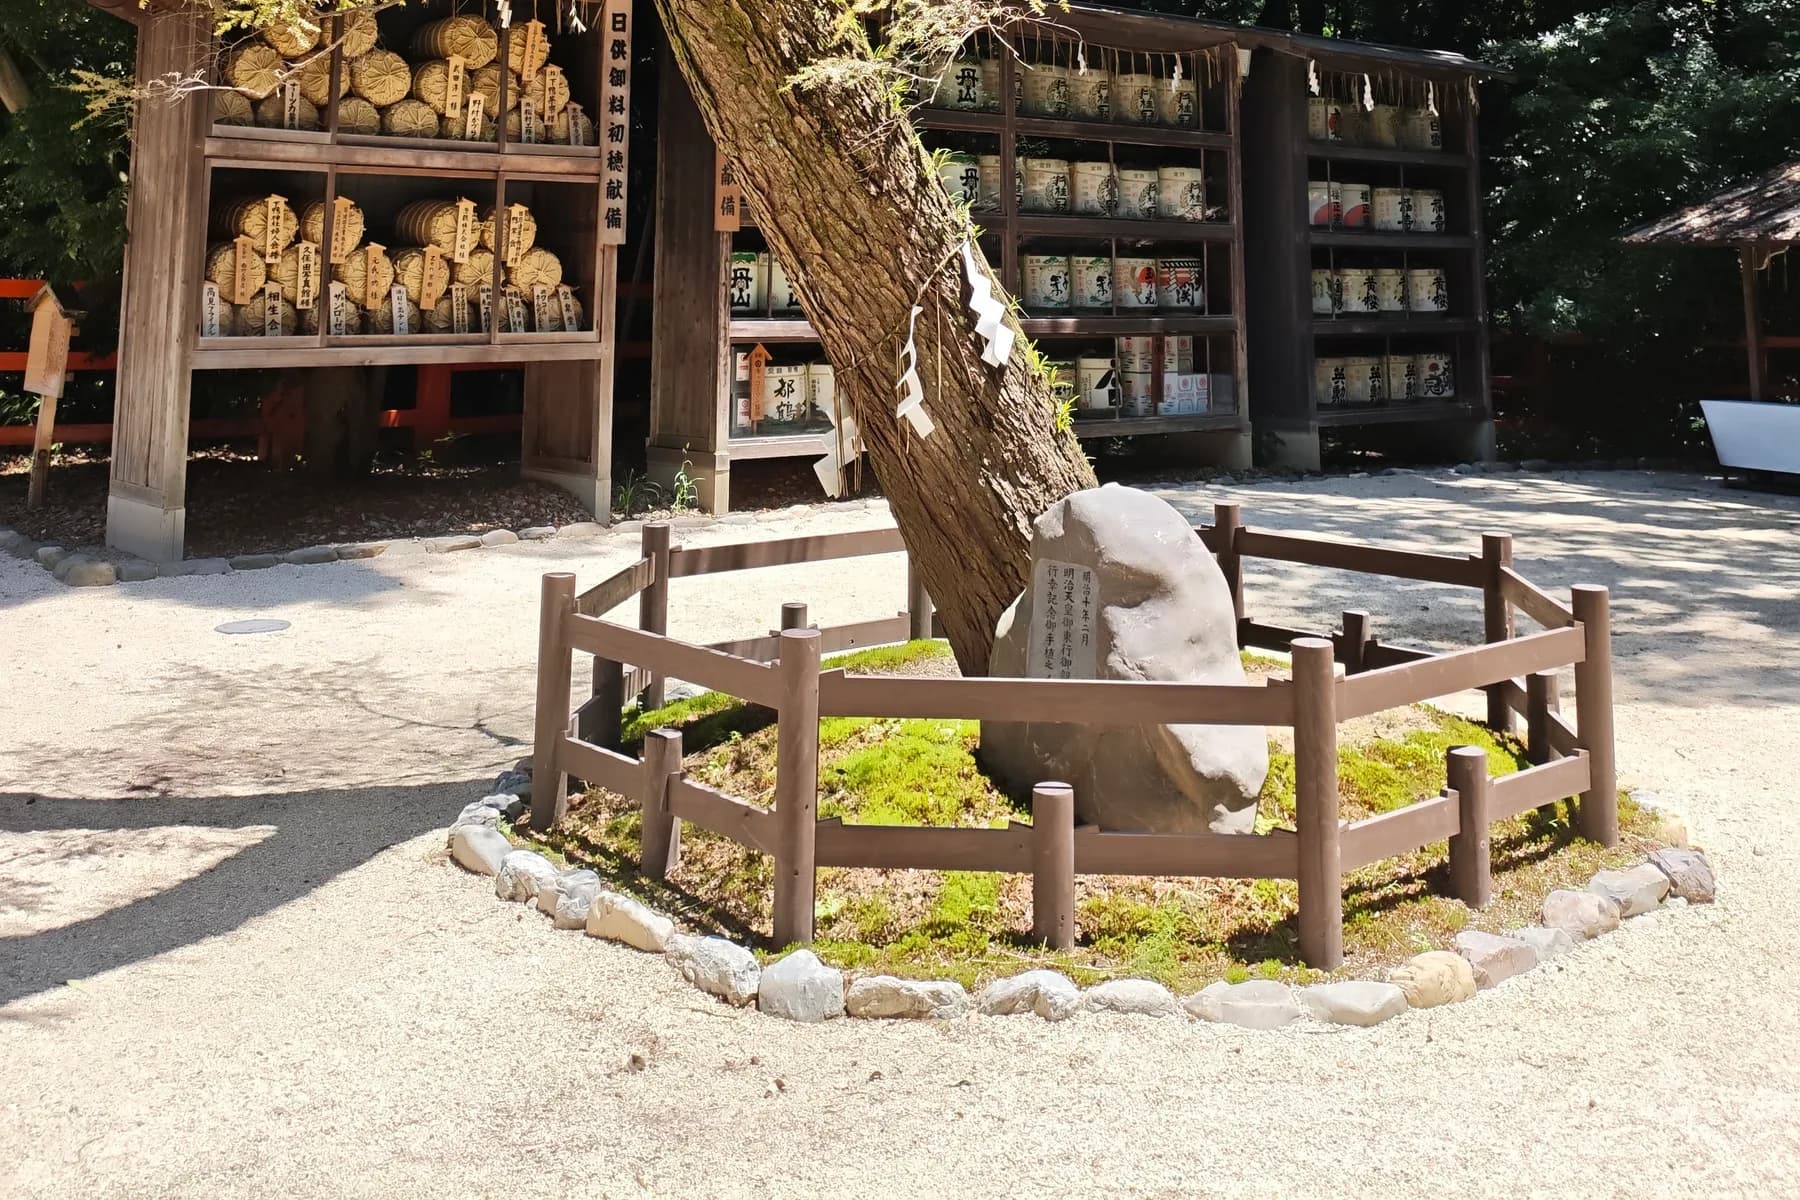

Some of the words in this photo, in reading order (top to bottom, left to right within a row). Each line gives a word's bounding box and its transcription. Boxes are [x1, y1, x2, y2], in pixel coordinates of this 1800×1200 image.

[955, 67, 979, 103] 丹山
[605, 13, 627, 229] 日供御料初穂献備
[731, 267, 753, 307] 丹山
[774, 378, 796, 421] 都鶴
